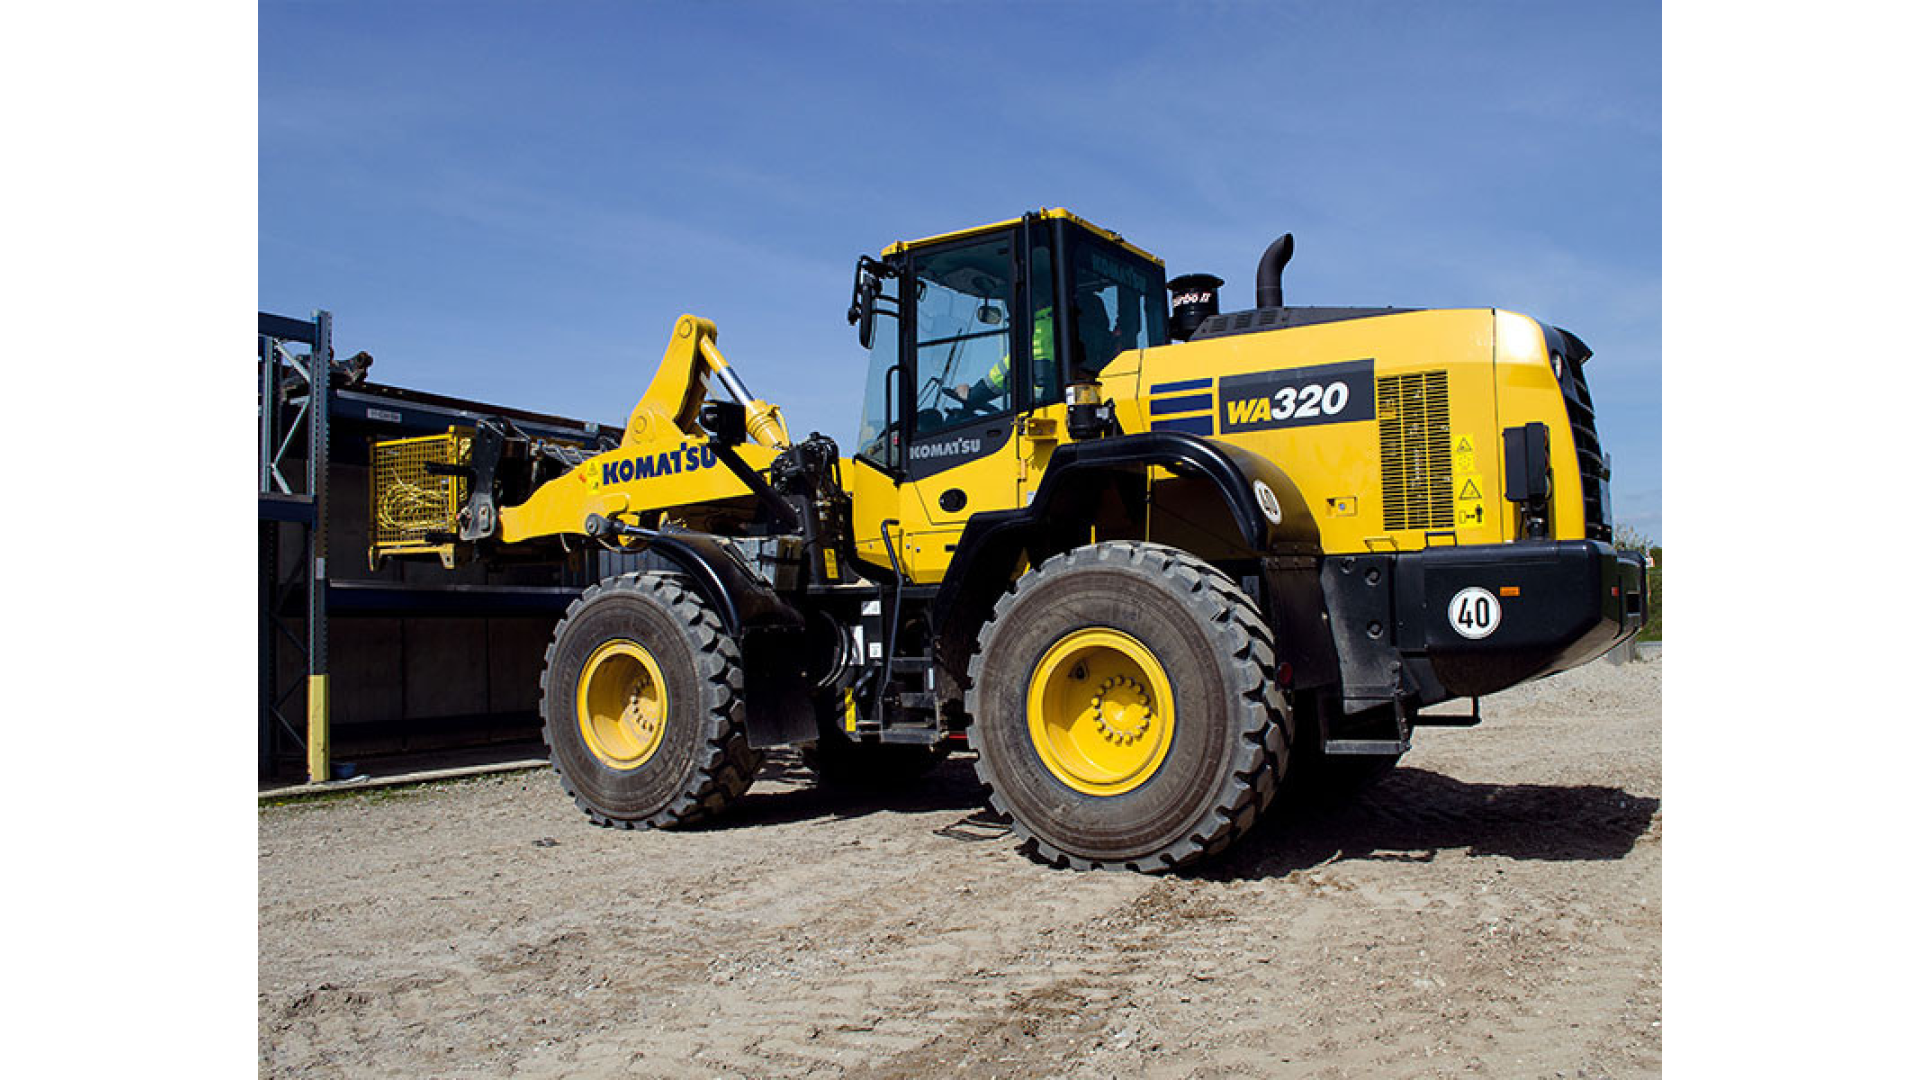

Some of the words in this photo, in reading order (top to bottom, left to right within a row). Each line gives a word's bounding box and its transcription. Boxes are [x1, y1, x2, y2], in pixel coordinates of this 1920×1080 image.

[1227, 381, 1349, 426] WA320
[602, 442, 717, 486] KOMATSU
[909, 436, 981, 460] KOMATSU
[1458, 597, 1490, 629] 40
